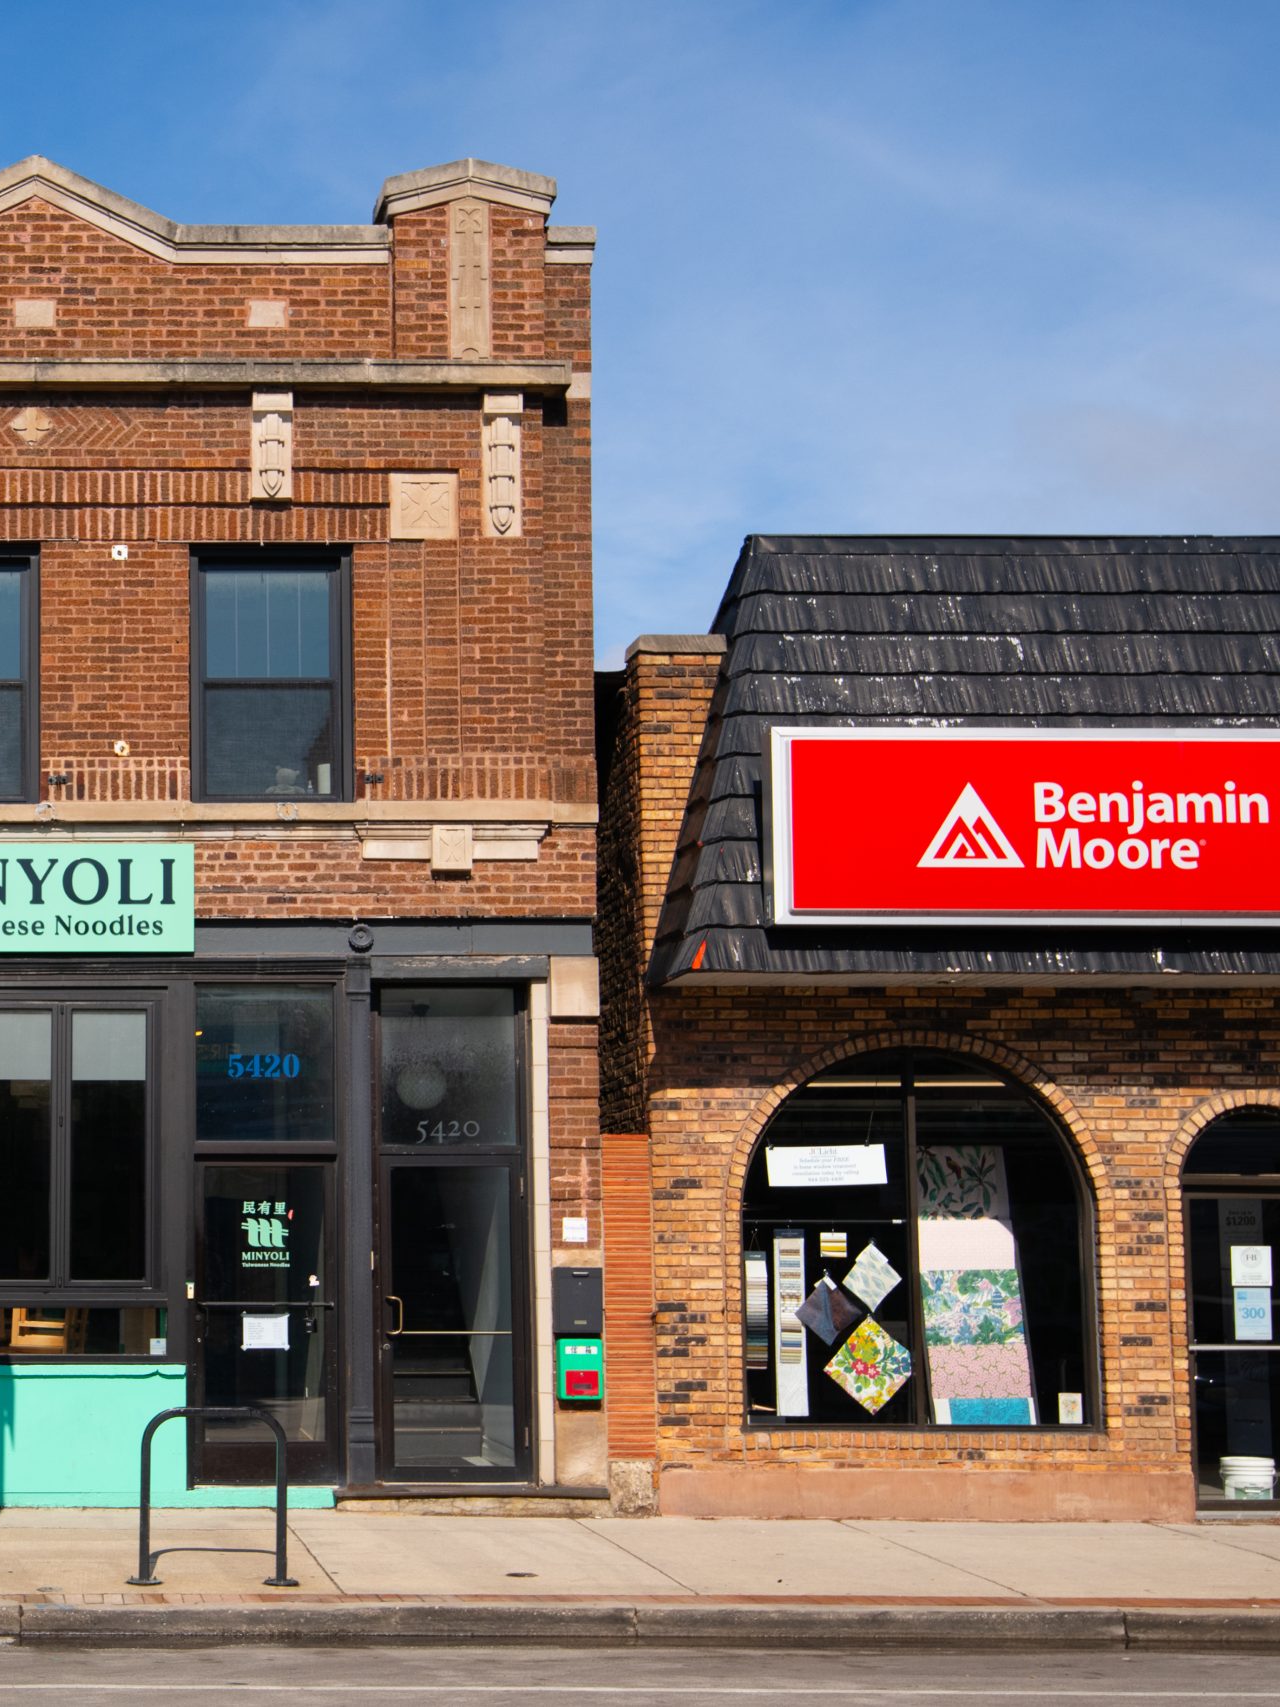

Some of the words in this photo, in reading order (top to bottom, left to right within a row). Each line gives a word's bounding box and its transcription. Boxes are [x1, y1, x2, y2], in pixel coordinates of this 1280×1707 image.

[1033, 780, 1270, 835] Benjamin
[1036, 828, 1200, 869] Moore
[54, 914, 164, 936] Noodles
[227, 1053, 300, 1078] 5420
[416, 1119, 480, 1144] 5420
[242, 1200, 287, 1215] 民有里
[241, 1251, 290, 1261] MINYOLI
